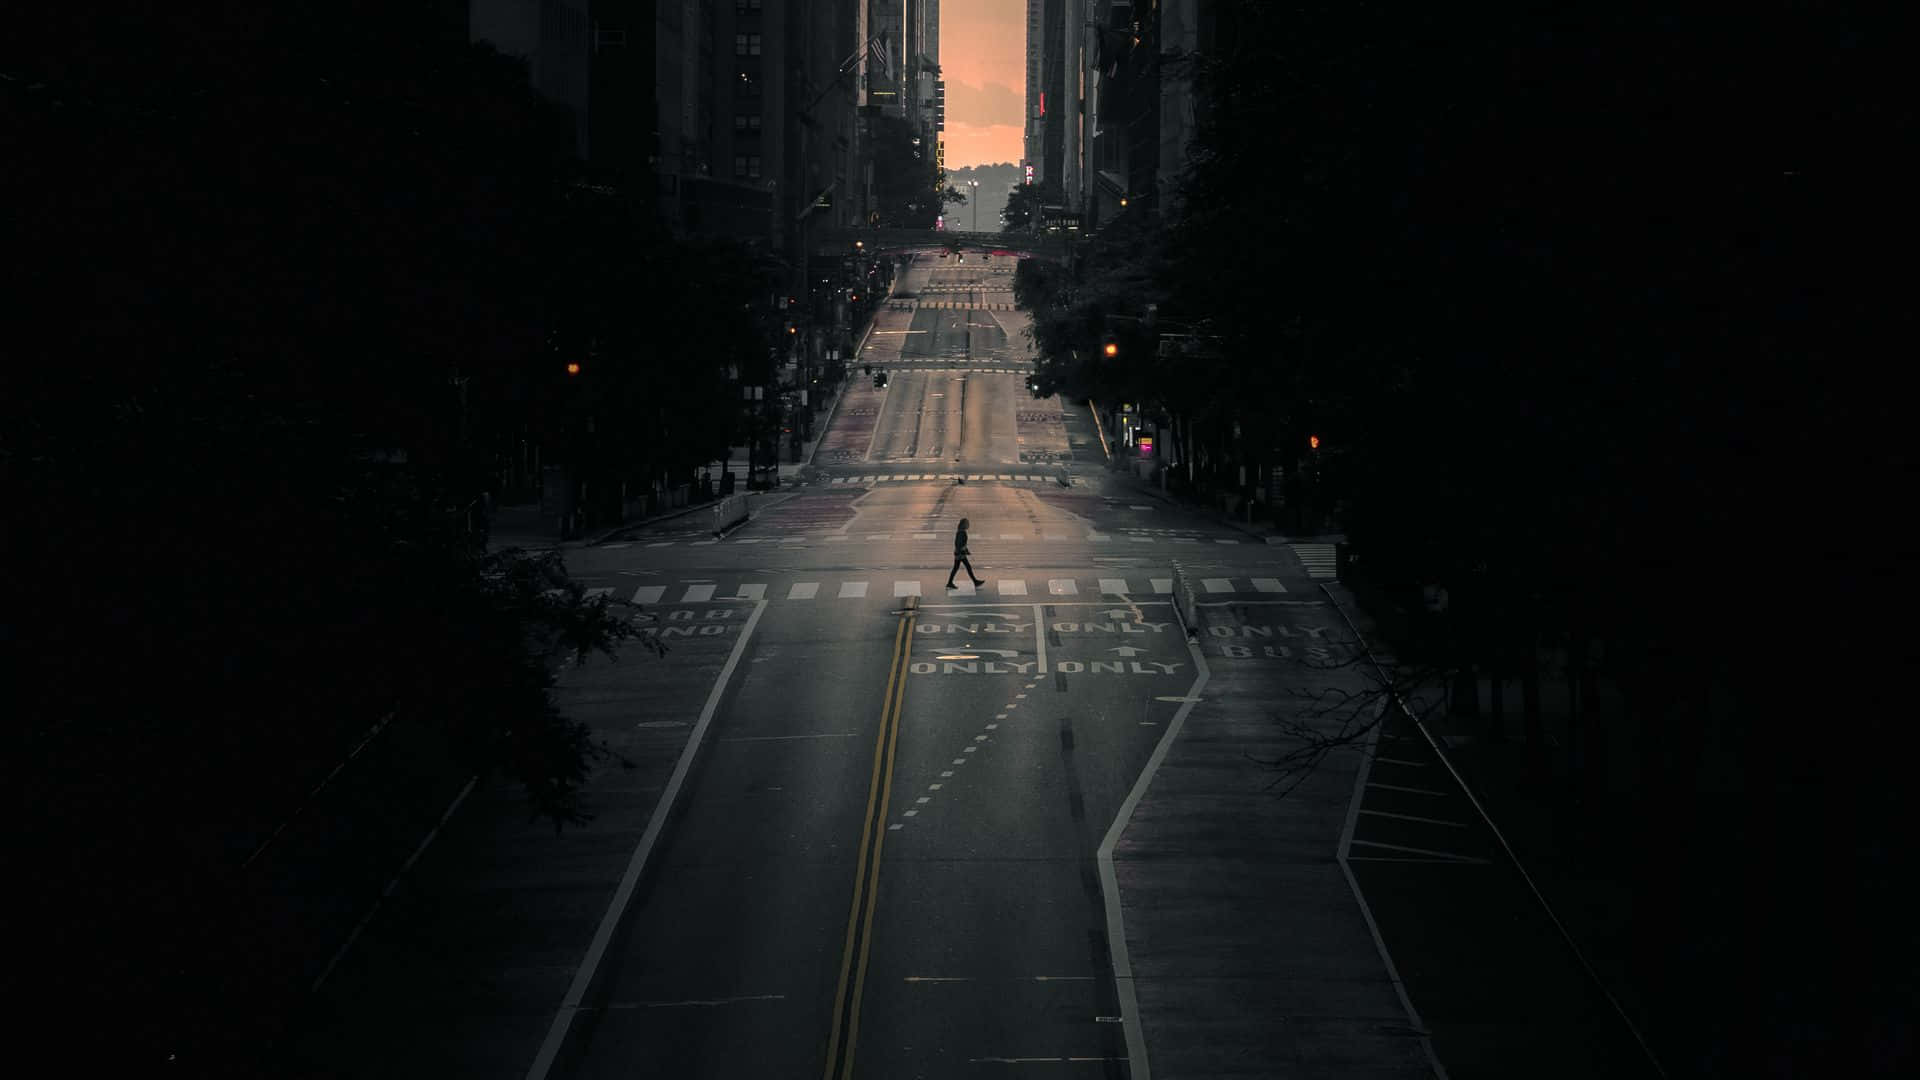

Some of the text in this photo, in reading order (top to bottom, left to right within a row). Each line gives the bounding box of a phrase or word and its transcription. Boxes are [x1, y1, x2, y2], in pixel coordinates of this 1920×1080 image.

[915, 623, 1034, 634] ONLY
[1052, 622, 1172, 633] ONLY
[1208, 625, 1328, 637] ONLY
[1221, 645, 1330, 657] BUS
[910, 661, 1037, 674] ONLY
[1057, 661, 1184, 674] ONLY
